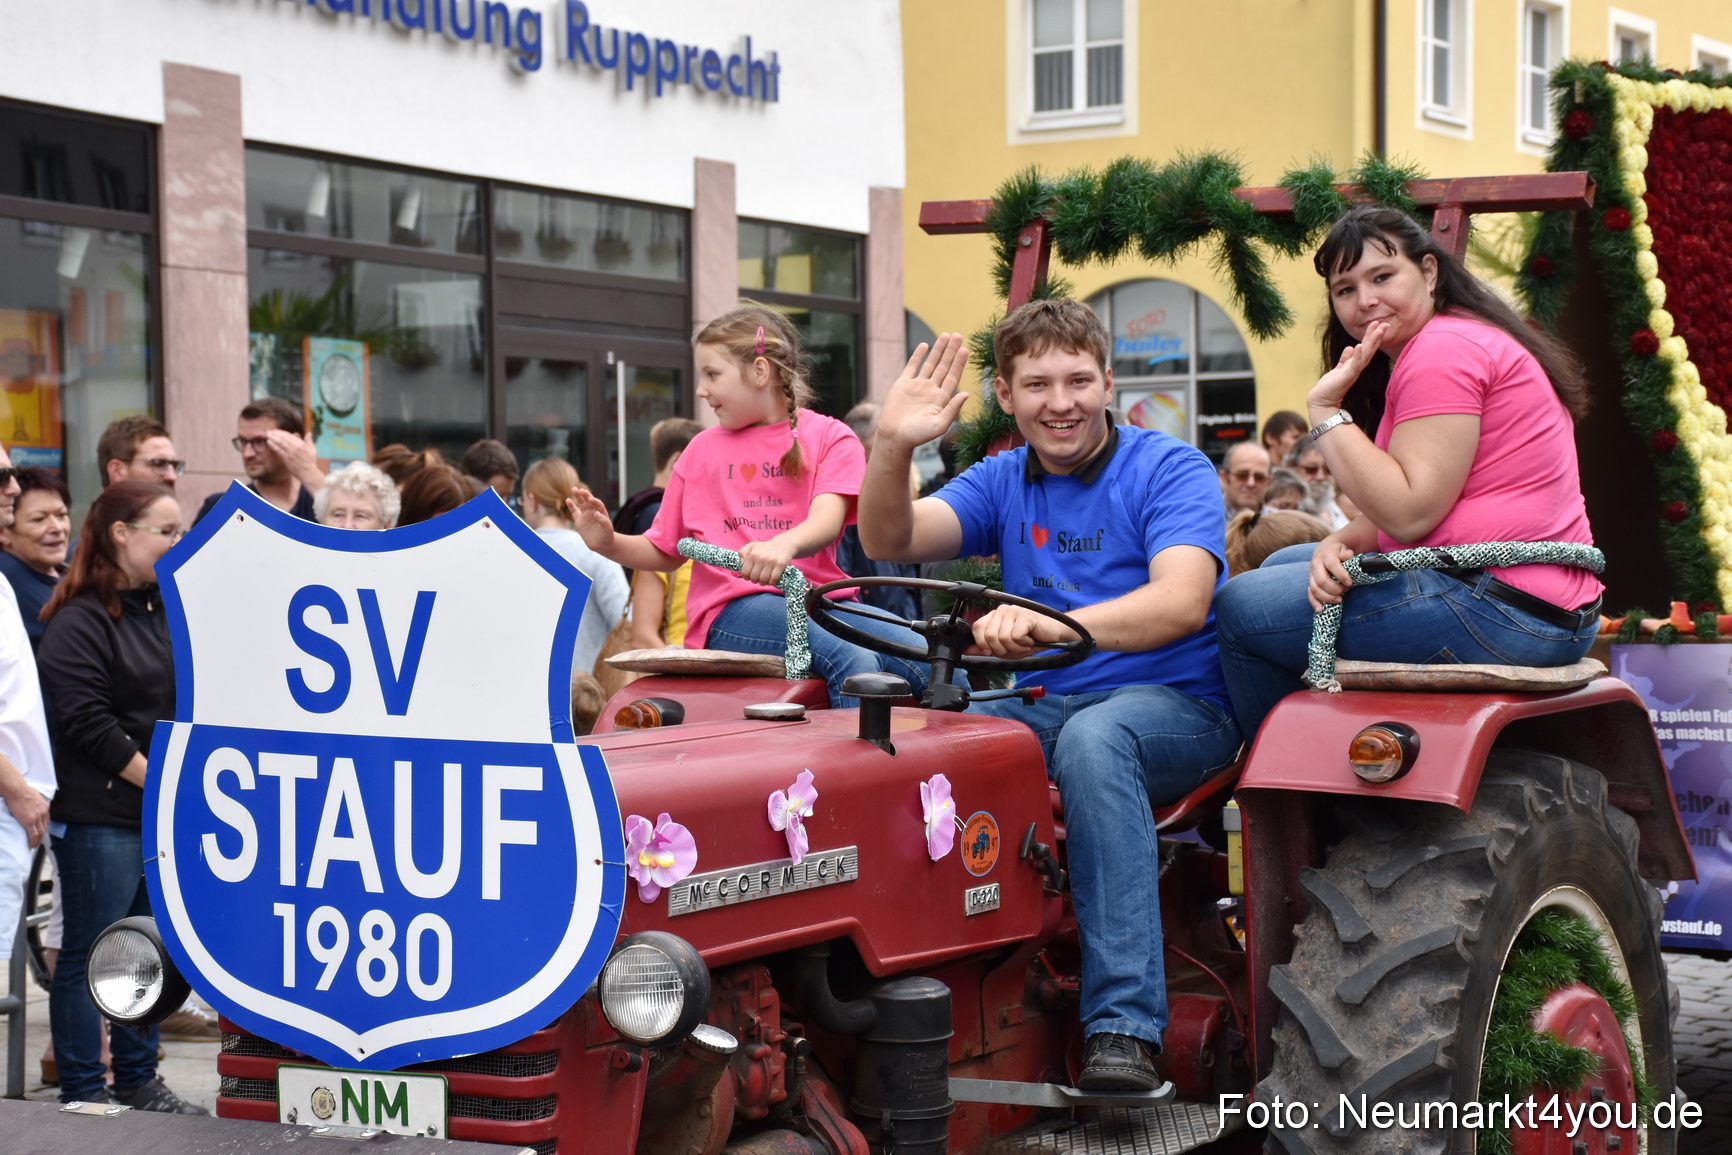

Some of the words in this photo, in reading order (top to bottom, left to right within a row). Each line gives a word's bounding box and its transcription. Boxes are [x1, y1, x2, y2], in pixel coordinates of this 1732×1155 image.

[564, 0, 781, 103] Rupprecht
[727, 464, 734, 479] I
[743, 496, 762, 508] und
[765, 496, 783, 507] das
[1019, 522, 1025, 544] I
[1057, 528, 1104, 553] Stauf
[1032, 574, 1055, 588] und
[1057, 577, 1080, 593] das
[285, 584, 438, 716] SV
[1661, 708, 1712, 723] spielen
[1675, 727, 1724, 742] machst
[202, 746, 543, 900] STAUF
[1660, 919, 1723, 936] vstauf.de
[273, 902, 453, 1001] 1980
[341, 1078, 409, 1126] NM
